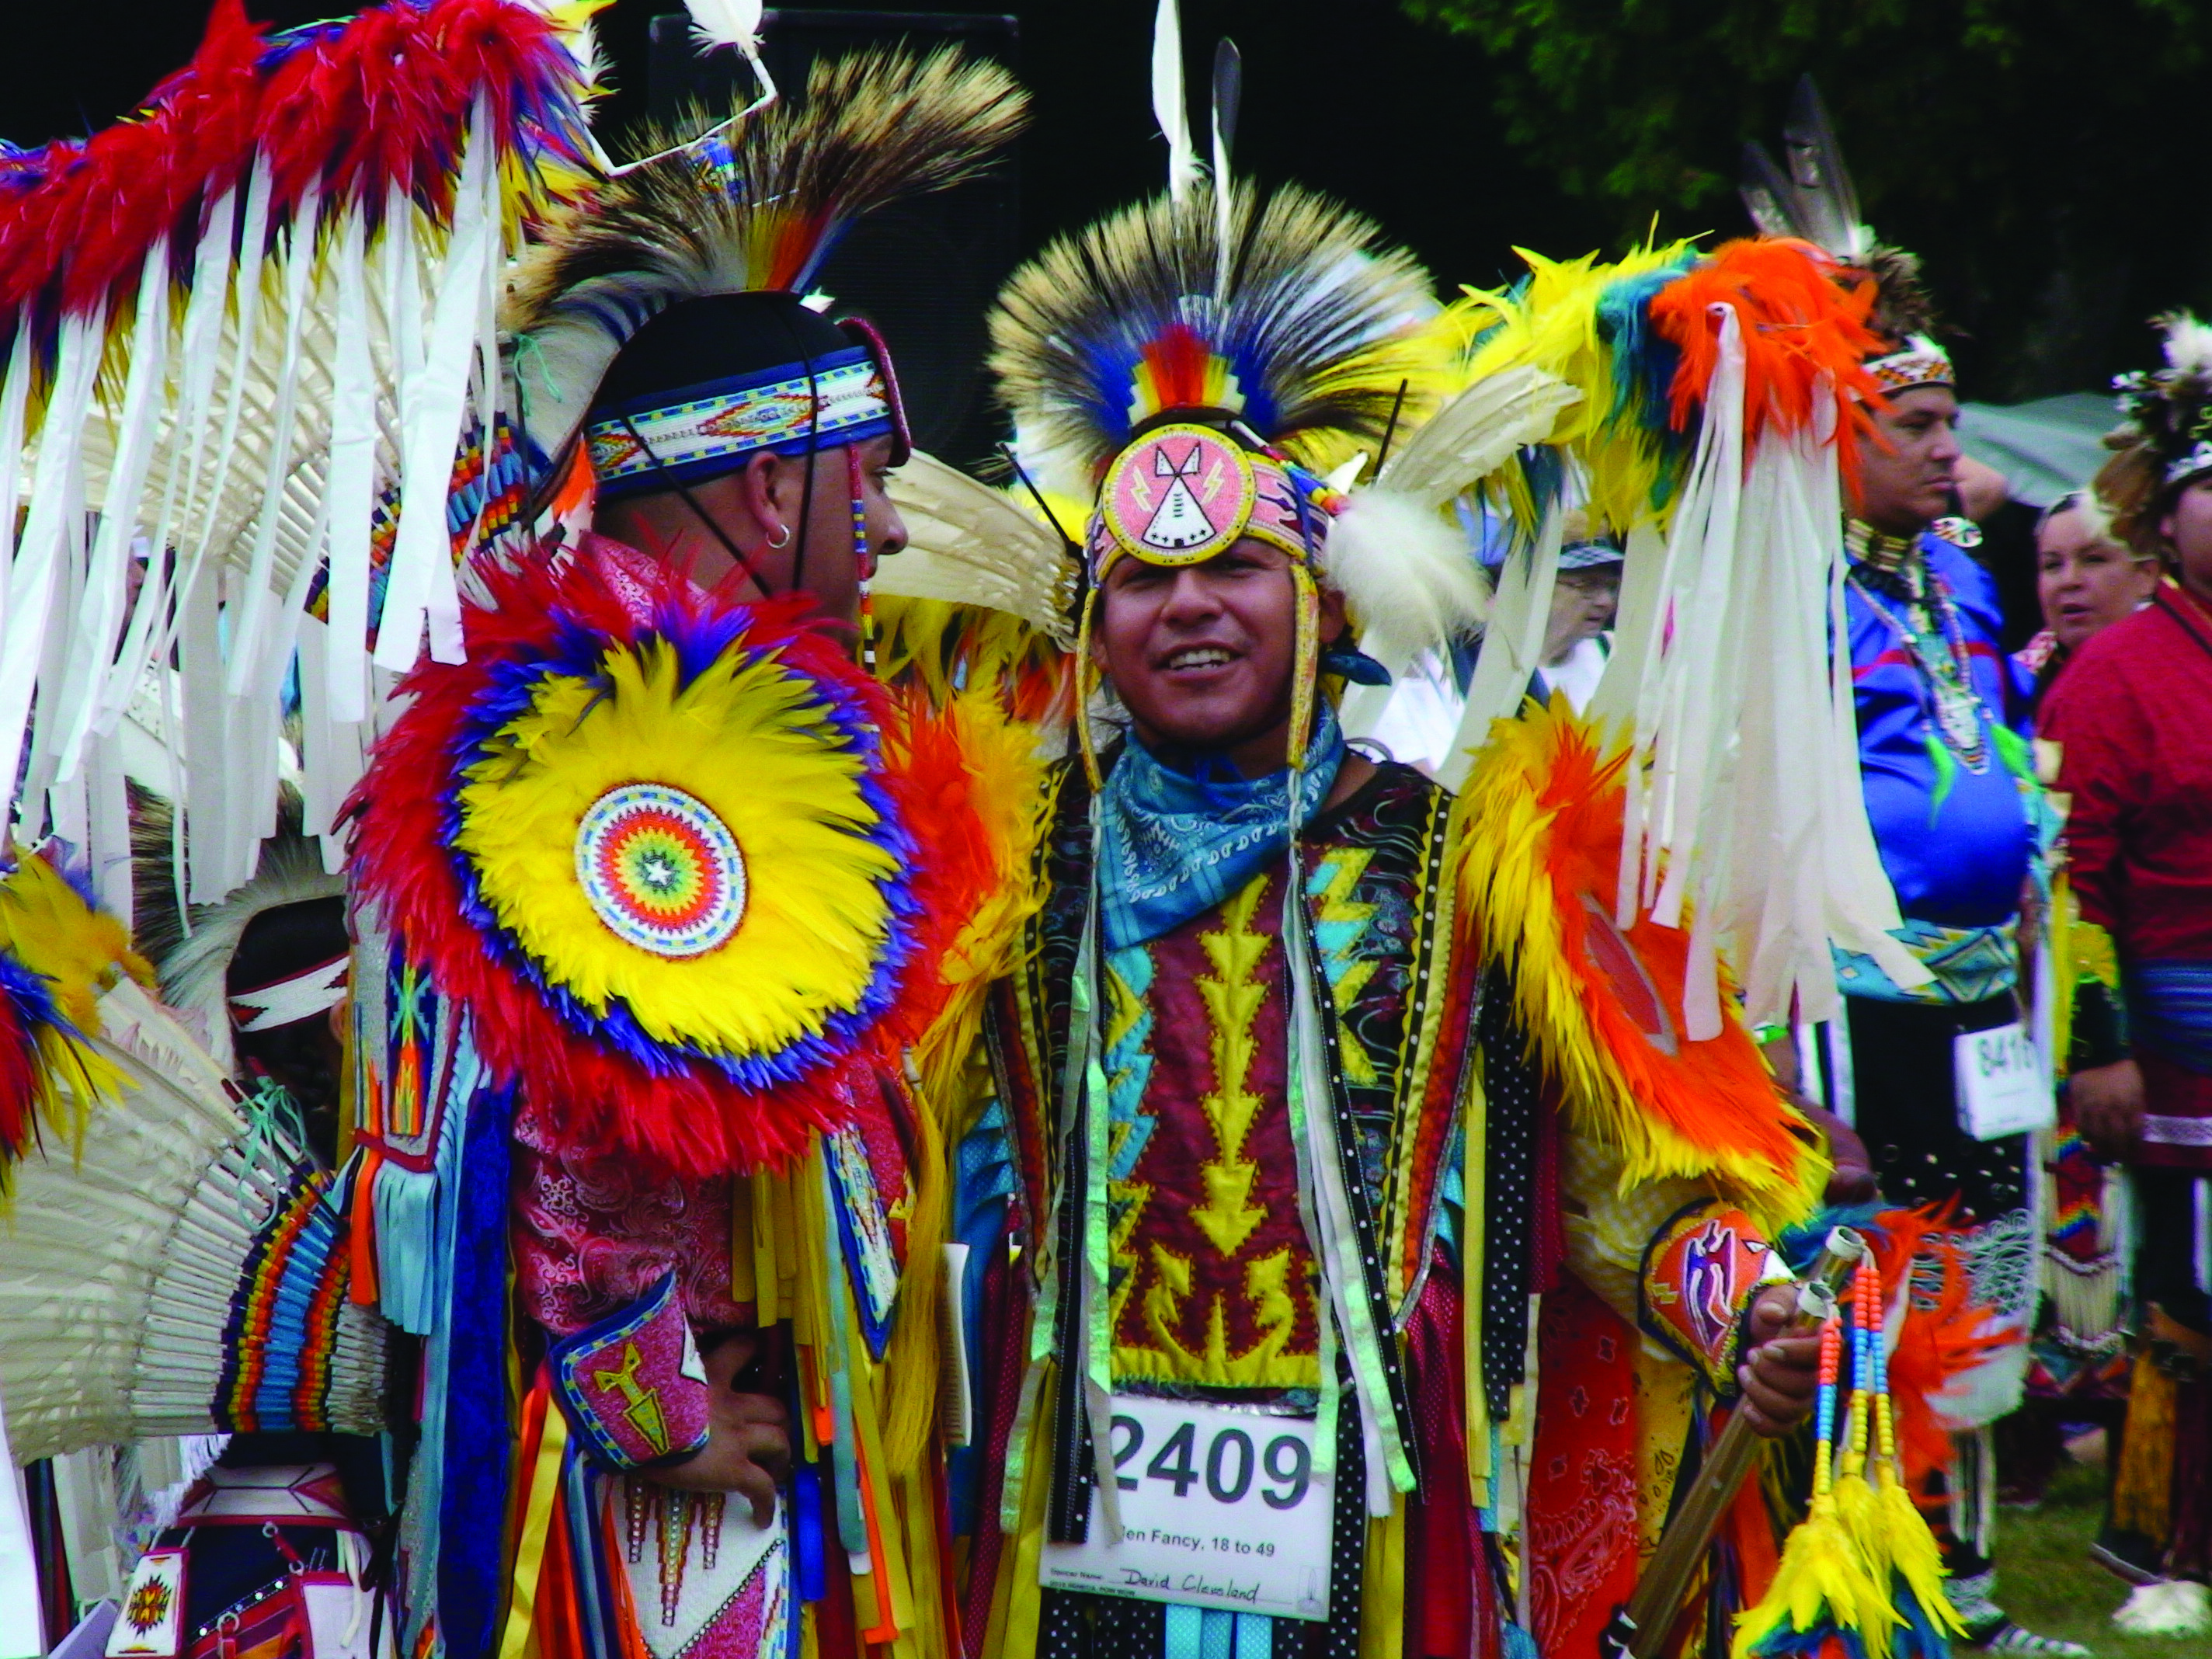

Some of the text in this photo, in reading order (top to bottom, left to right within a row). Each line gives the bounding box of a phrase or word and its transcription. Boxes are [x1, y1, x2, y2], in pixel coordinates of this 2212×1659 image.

[1094, 1415, 1312, 1510] 2409
[1122, 1525, 1275, 1556] en Fancy, 18 to 49
[1181, 1574, 1260, 1605] Cleveland
